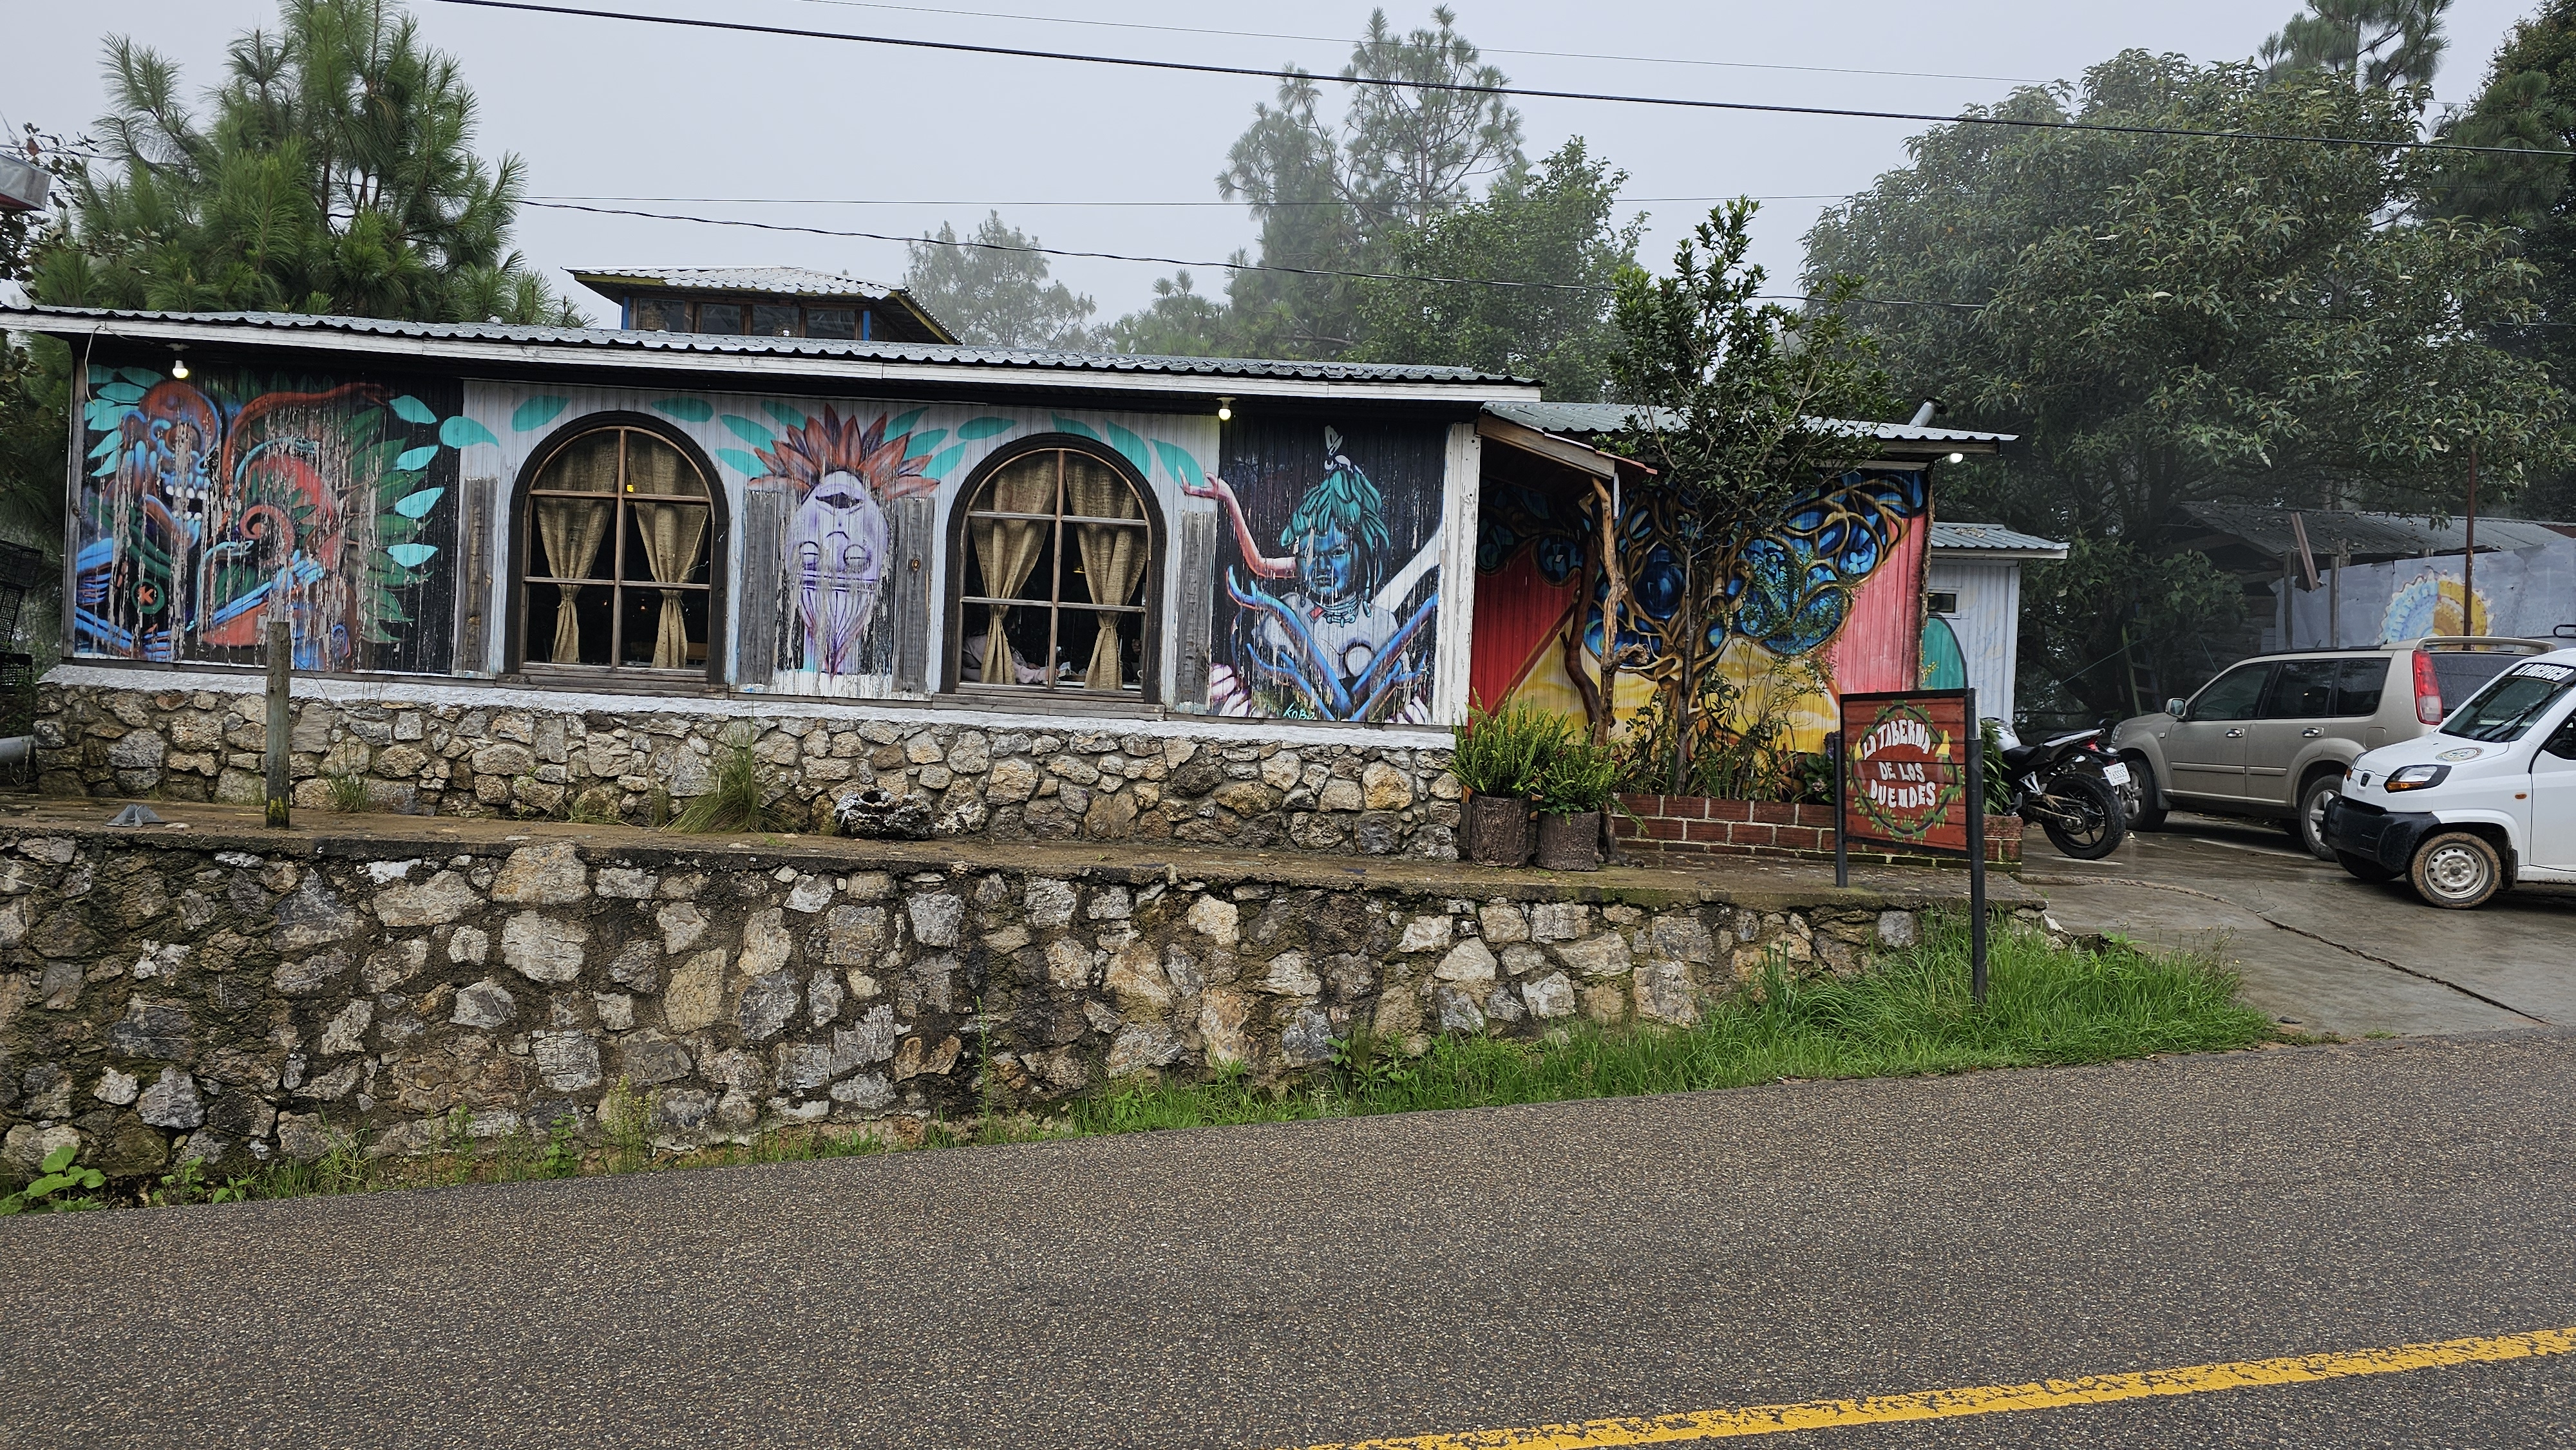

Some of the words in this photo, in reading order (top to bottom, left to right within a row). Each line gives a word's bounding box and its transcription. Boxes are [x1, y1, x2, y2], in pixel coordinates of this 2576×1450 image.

[1864, 735, 1877, 760] LA
[1877, 719, 1931, 754] TABERNA
[1879, 761, 1897, 780] DE
[1898, 762, 1926, 782] LOS
[1870, 778, 1936, 808] DUENDES
